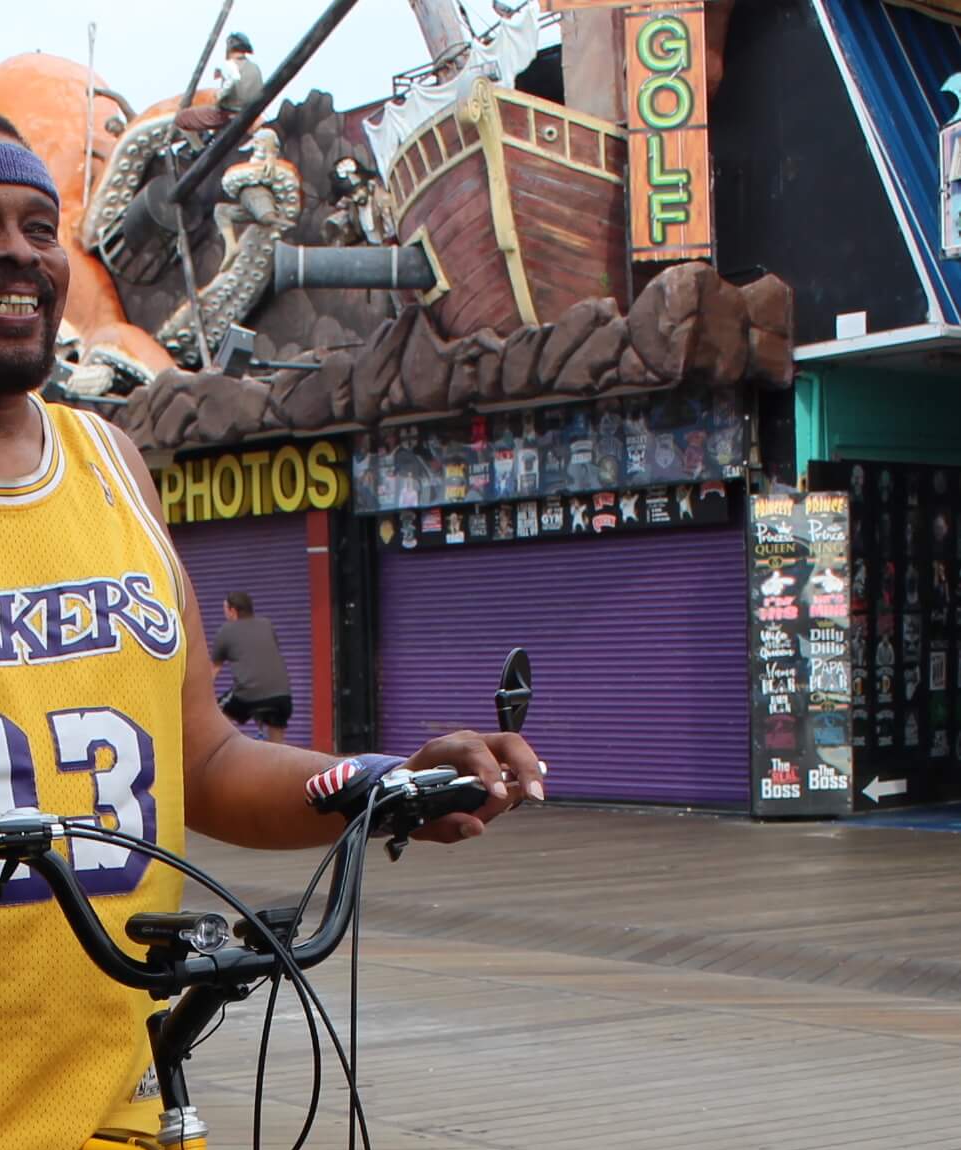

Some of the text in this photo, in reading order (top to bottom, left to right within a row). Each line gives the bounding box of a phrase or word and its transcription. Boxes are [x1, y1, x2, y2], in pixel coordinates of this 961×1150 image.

[636, 17, 694, 245] GOLF
[161, 441, 340, 524] PHOTOS
[805, 496, 845, 515] PRINCE
[755, 522, 794, 544] Princess
[807, 519, 847, 543] Prince
[755, 544, 796, 555] QUEEN
[810, 629, 844, 643] Dilly
[810, 642, 846, 656] Dilly
[771, 757, 790, 772] The
[818, 764, 835, 776] The
